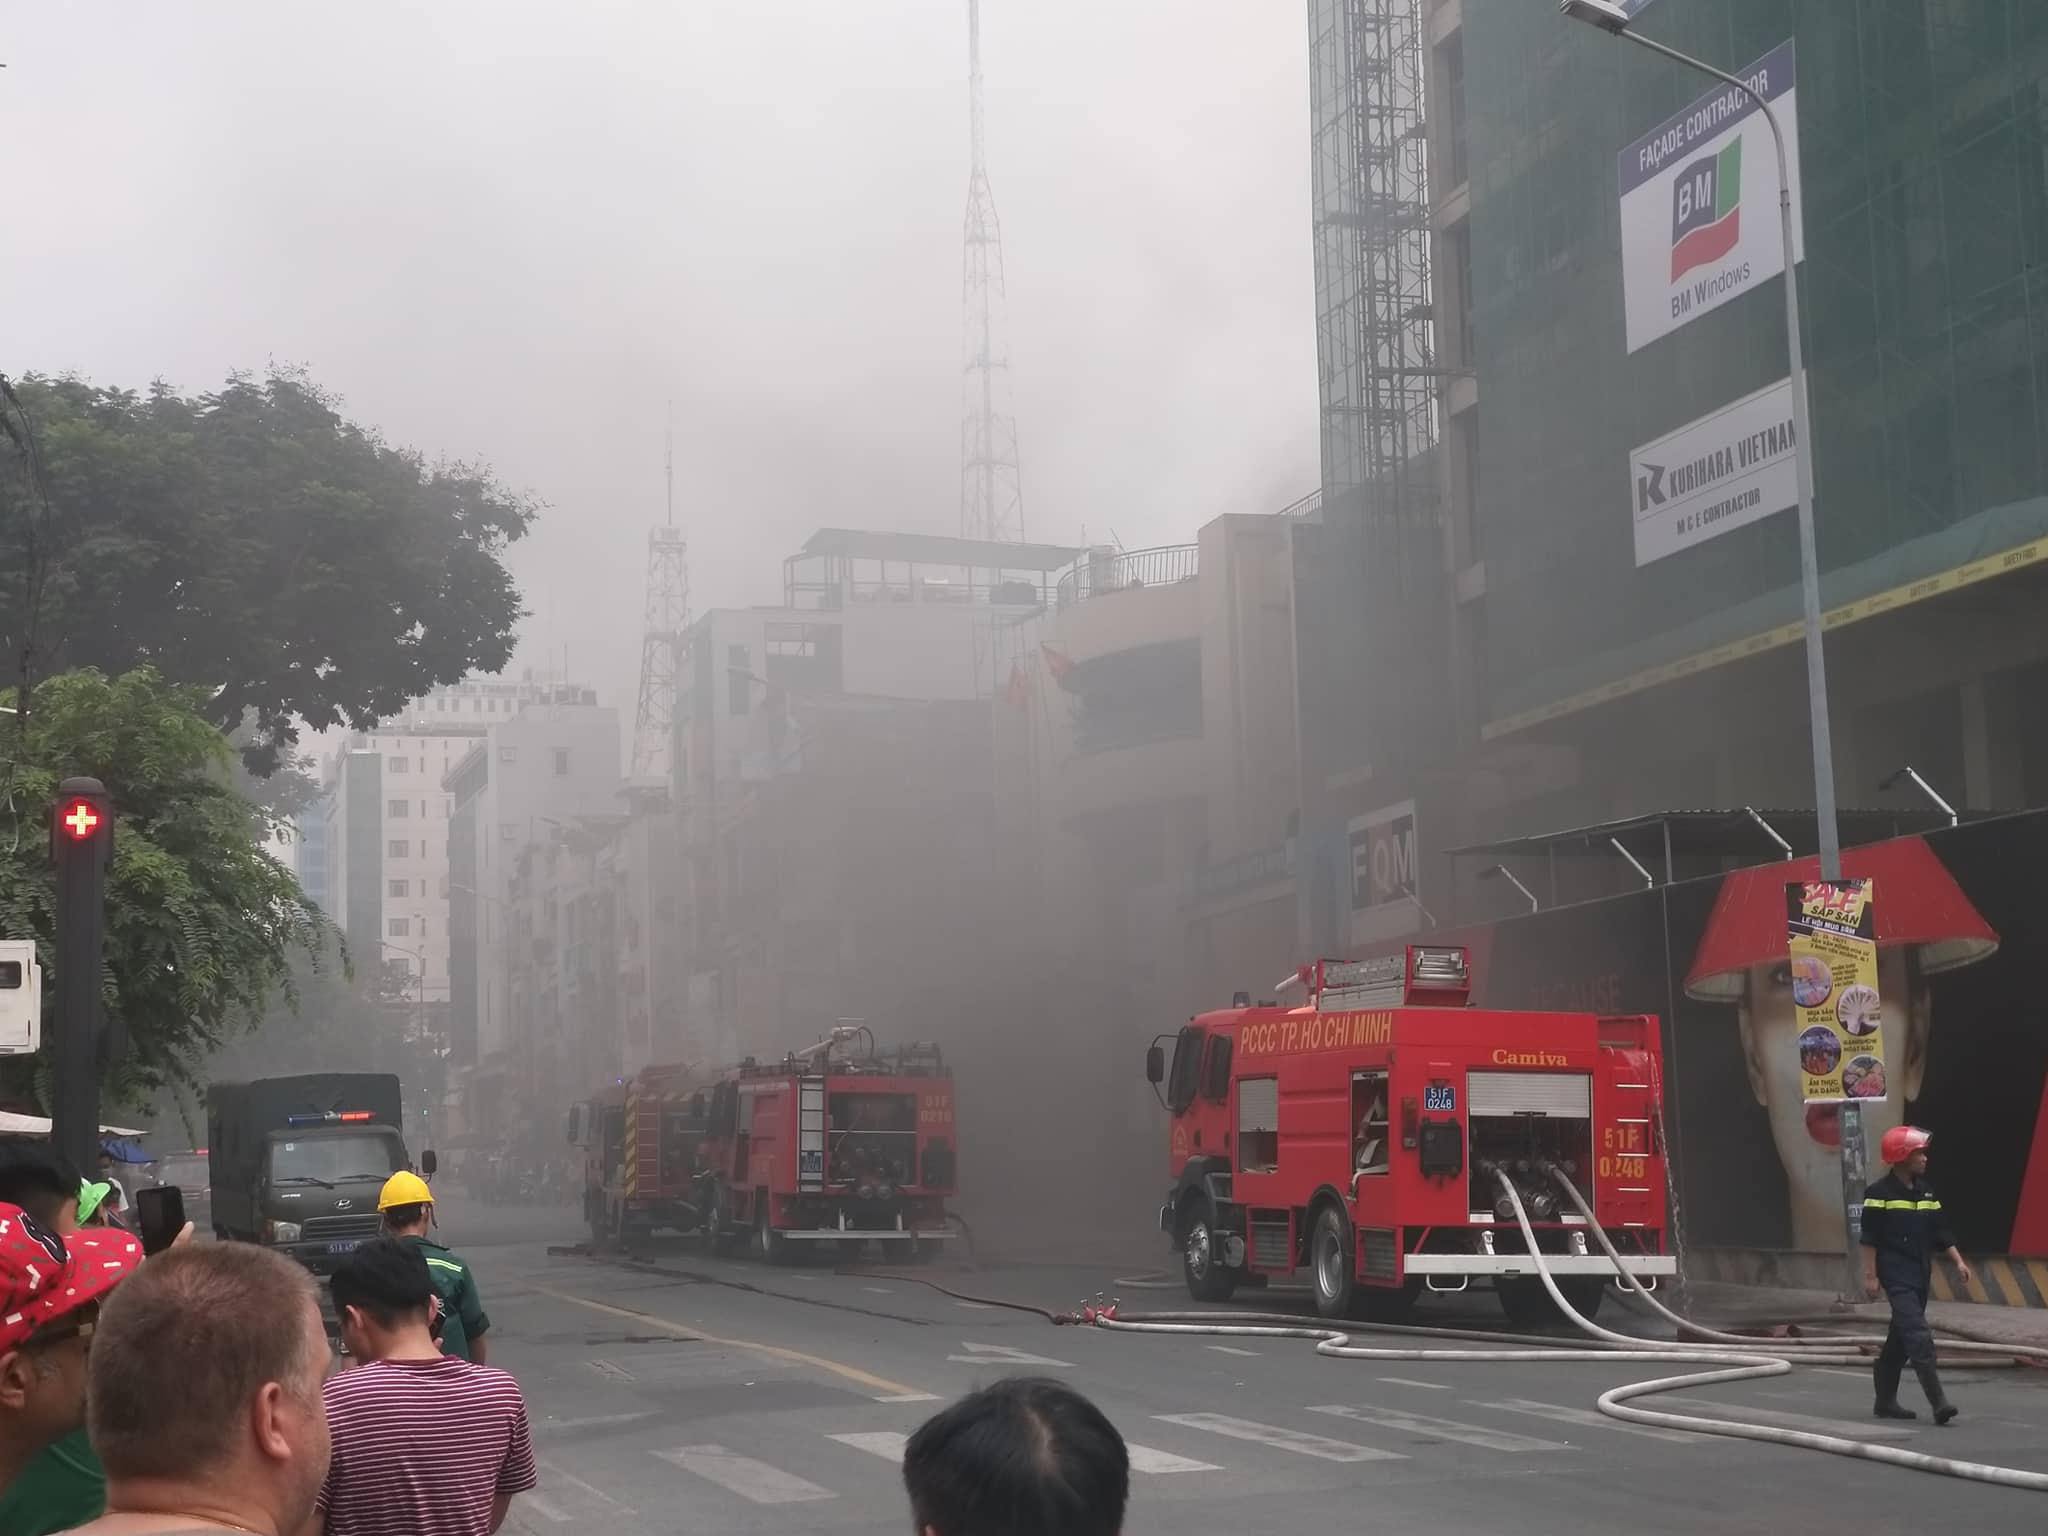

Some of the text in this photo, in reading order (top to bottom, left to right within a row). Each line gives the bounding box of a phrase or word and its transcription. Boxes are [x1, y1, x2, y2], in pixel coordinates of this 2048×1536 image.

[1640, 69, 1768, 171] FAÇADE CONTRACTOR
[1679, 171, 1712, 224] BM
[1671, 262, 1750, 319] BM Windows
[1669, 446, 1734, 499] KURIHARA
[1677, 518, 1685, 536] M
[1695, 512, 1701, 528] E
[1703, 487, 1760, 525] CONTRACTOR
[1240, 1023, 1277, 1054] PCCC
[1353, 1012, 1392, 1046] MINH
[1492, 1050, 1568, 1066] Camiva
[1428, 1099, 1452, 1110] 0248
[1431, 1088, 1448, 1099] 51F
[1605, 1128, 1638, 1150] 51F
[1600, 1156, 1644, 1177] 0248
